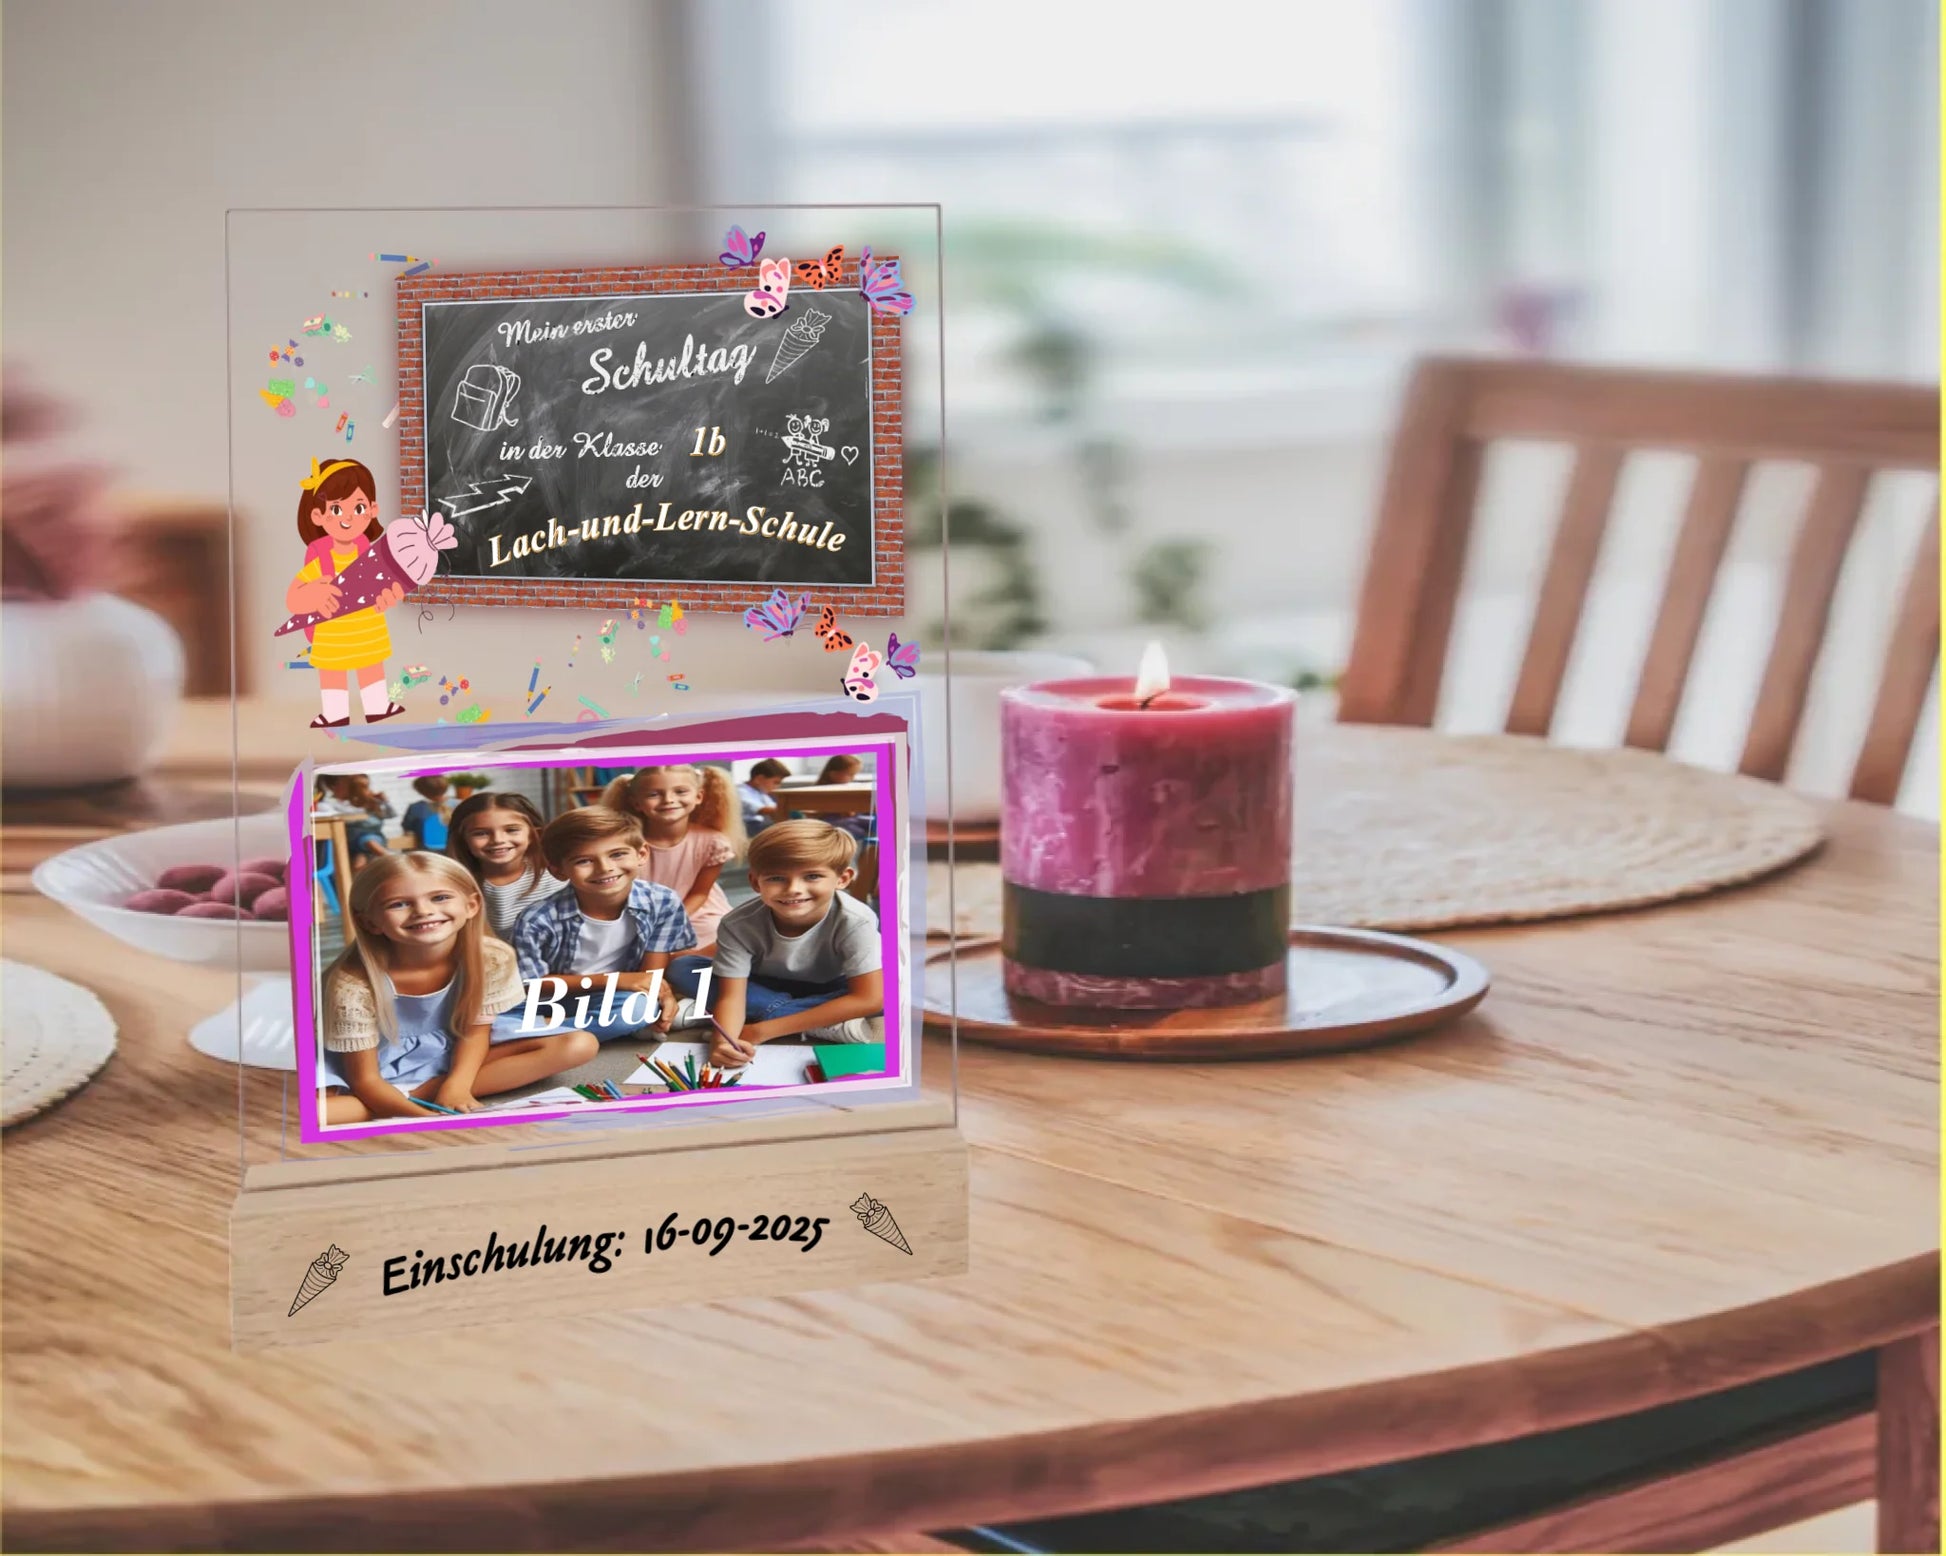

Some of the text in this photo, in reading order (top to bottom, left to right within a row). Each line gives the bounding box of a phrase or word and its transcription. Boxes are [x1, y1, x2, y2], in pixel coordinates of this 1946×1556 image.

[498, 309, 638, 348] Mein erster
[581, 334, 757, 395] Schultag
[500, 426, 727, 461] in der Klasse 1b
[626, 465, 663, 489] der
[780, 467, 825, 487] ABC
[488, 502, 847, 568] Lach-und-Lern-Schule
[514, 966, 714, 1034] Bild 1
[381, 1212, 831, 1297] Einschulung: 16-09-2025
